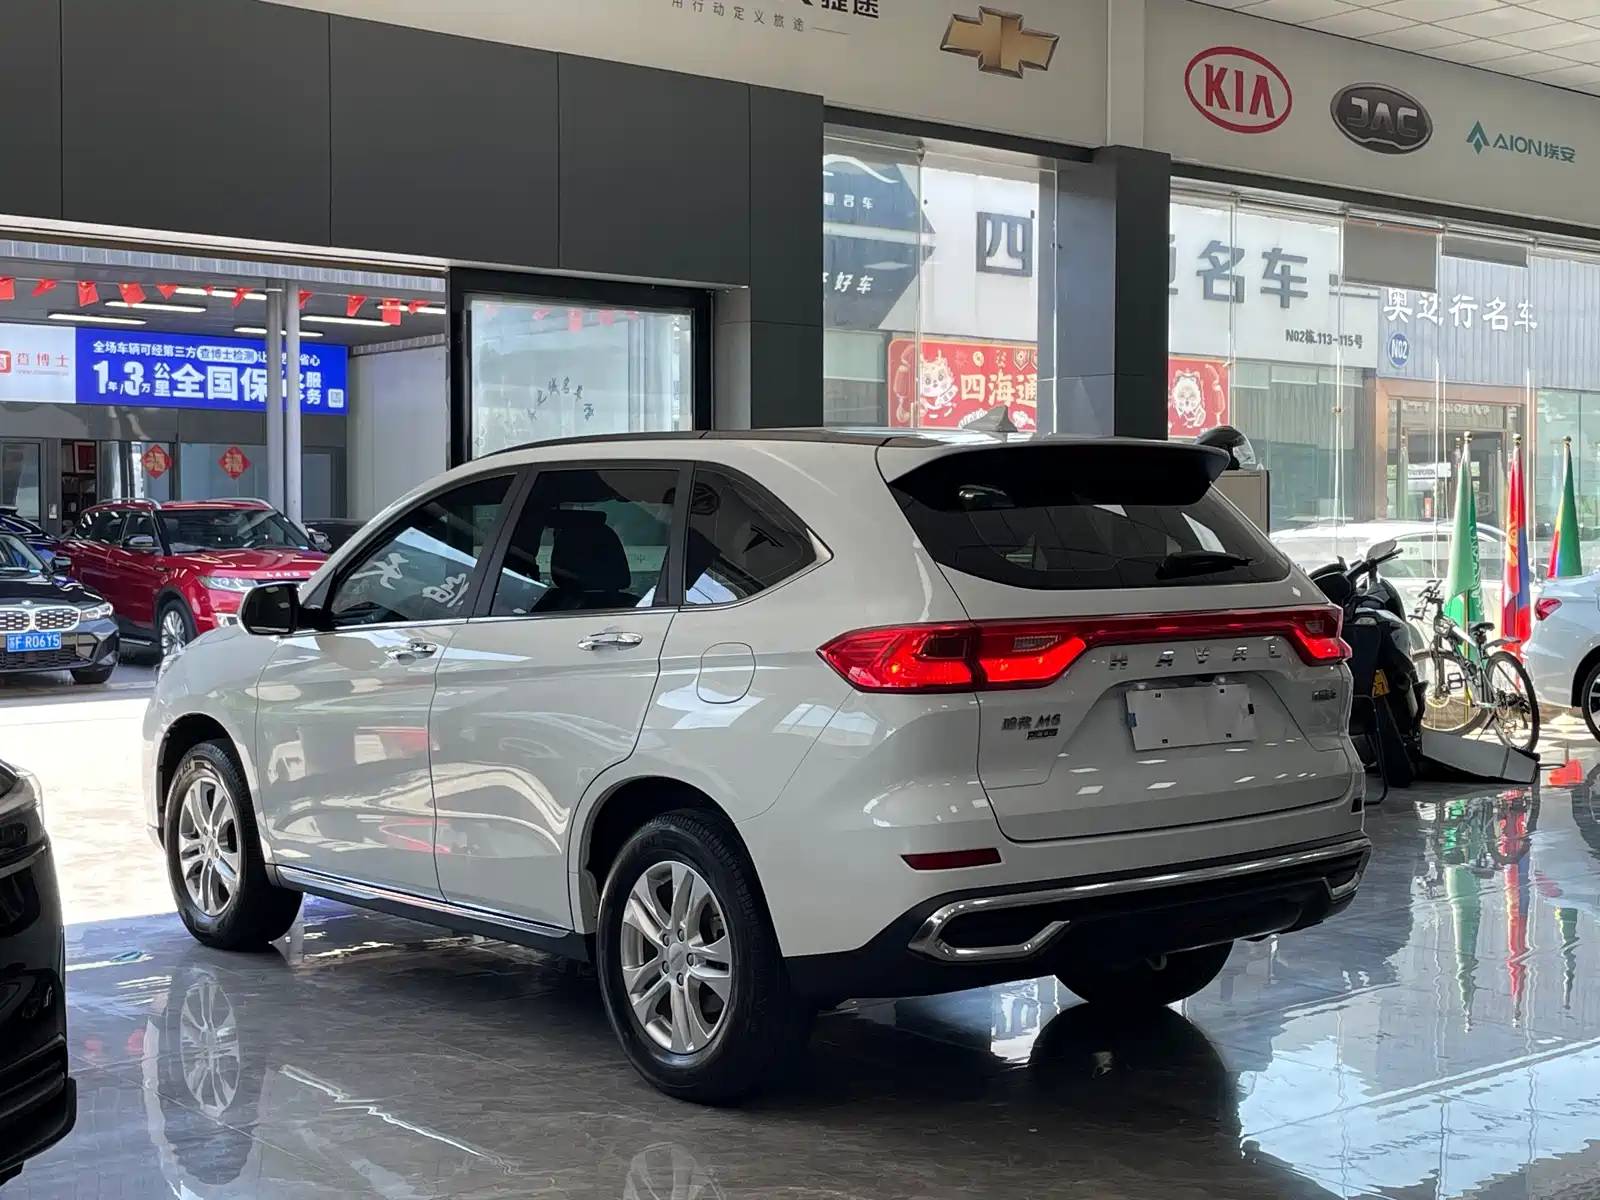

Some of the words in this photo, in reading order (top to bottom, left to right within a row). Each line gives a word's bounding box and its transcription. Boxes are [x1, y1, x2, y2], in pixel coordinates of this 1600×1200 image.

[1204, 64, 1275, 118] KIA
[1347, 97, 1419, 137] JAC
[1169, 234, 1309, 309] 名车
[1391, 339, 1409, 360] N02
[1109, 643, 1283, 670] HAVAL
